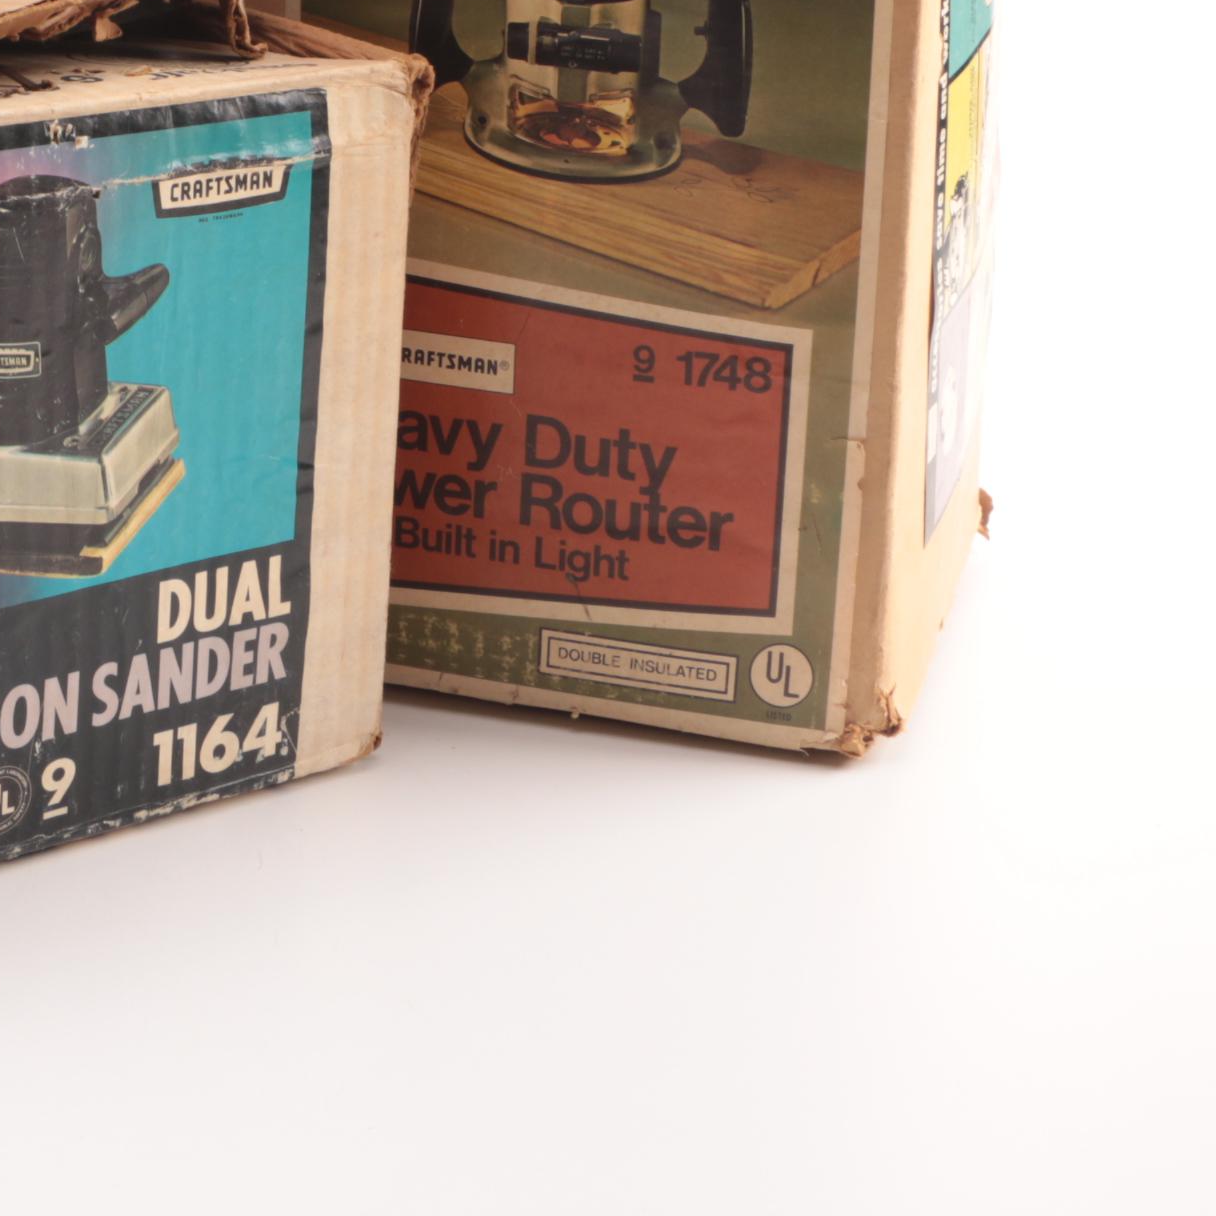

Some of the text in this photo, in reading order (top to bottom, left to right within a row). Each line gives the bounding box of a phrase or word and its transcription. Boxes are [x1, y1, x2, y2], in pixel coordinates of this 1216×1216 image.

[170, 169, 274, 203] CRAFTSMAN
[632, 344, 773, 394] 9 1748
[397, 409, 678, 496] avy Duty
[393, 468, 735, 552] wer Router
[394, 515, 630, 582] Built in Light
[156, 554, 292, 645] DUAL
[91, 621, 290, 728] SANDER
[557, 646, 718, 682] DOUBLE INSULATED
[766, 650, 800, 699] UL
[41, 757, 77, 807] 9
[152, 701, 283, 786] 1164
